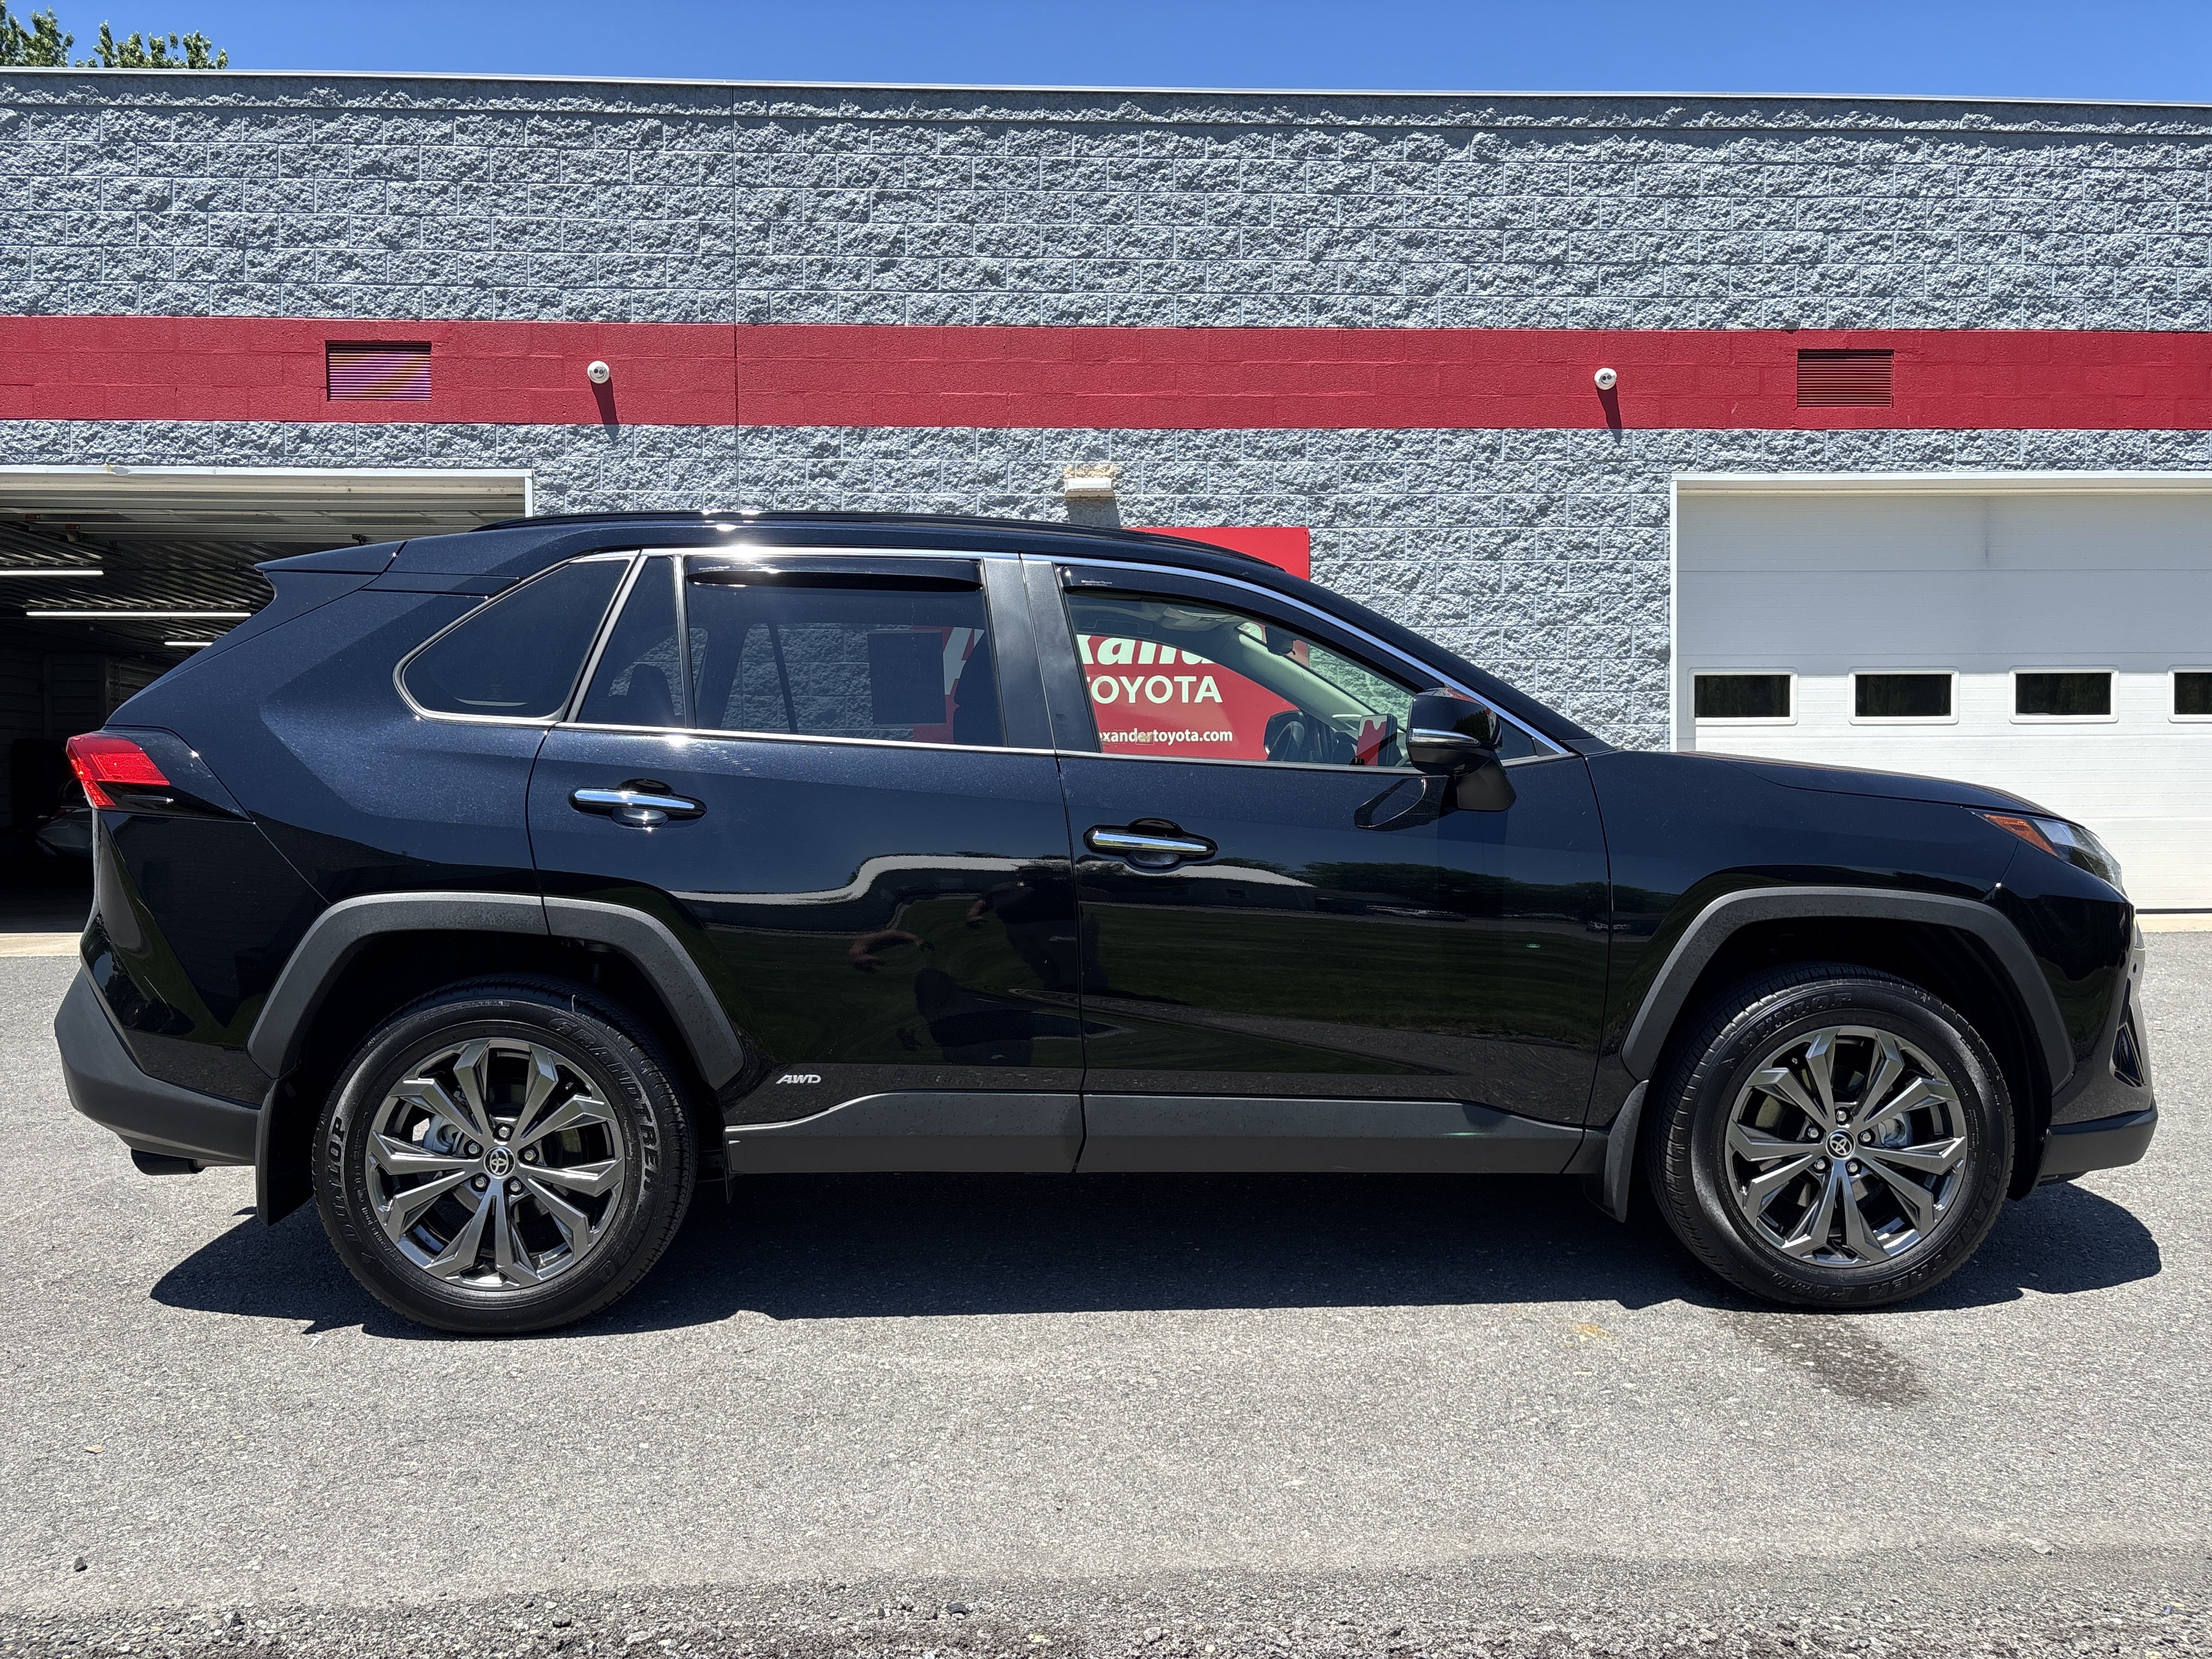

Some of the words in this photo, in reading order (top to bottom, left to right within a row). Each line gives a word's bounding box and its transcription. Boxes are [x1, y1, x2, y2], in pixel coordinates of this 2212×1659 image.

[1086, 675, 1223, 704] OYOTA
[1739, 992, 1853, 1053] DUNLOP
[775, 1074, 822, 1084] AWD
[328, 1116, 363, 1244] DUNLOP
